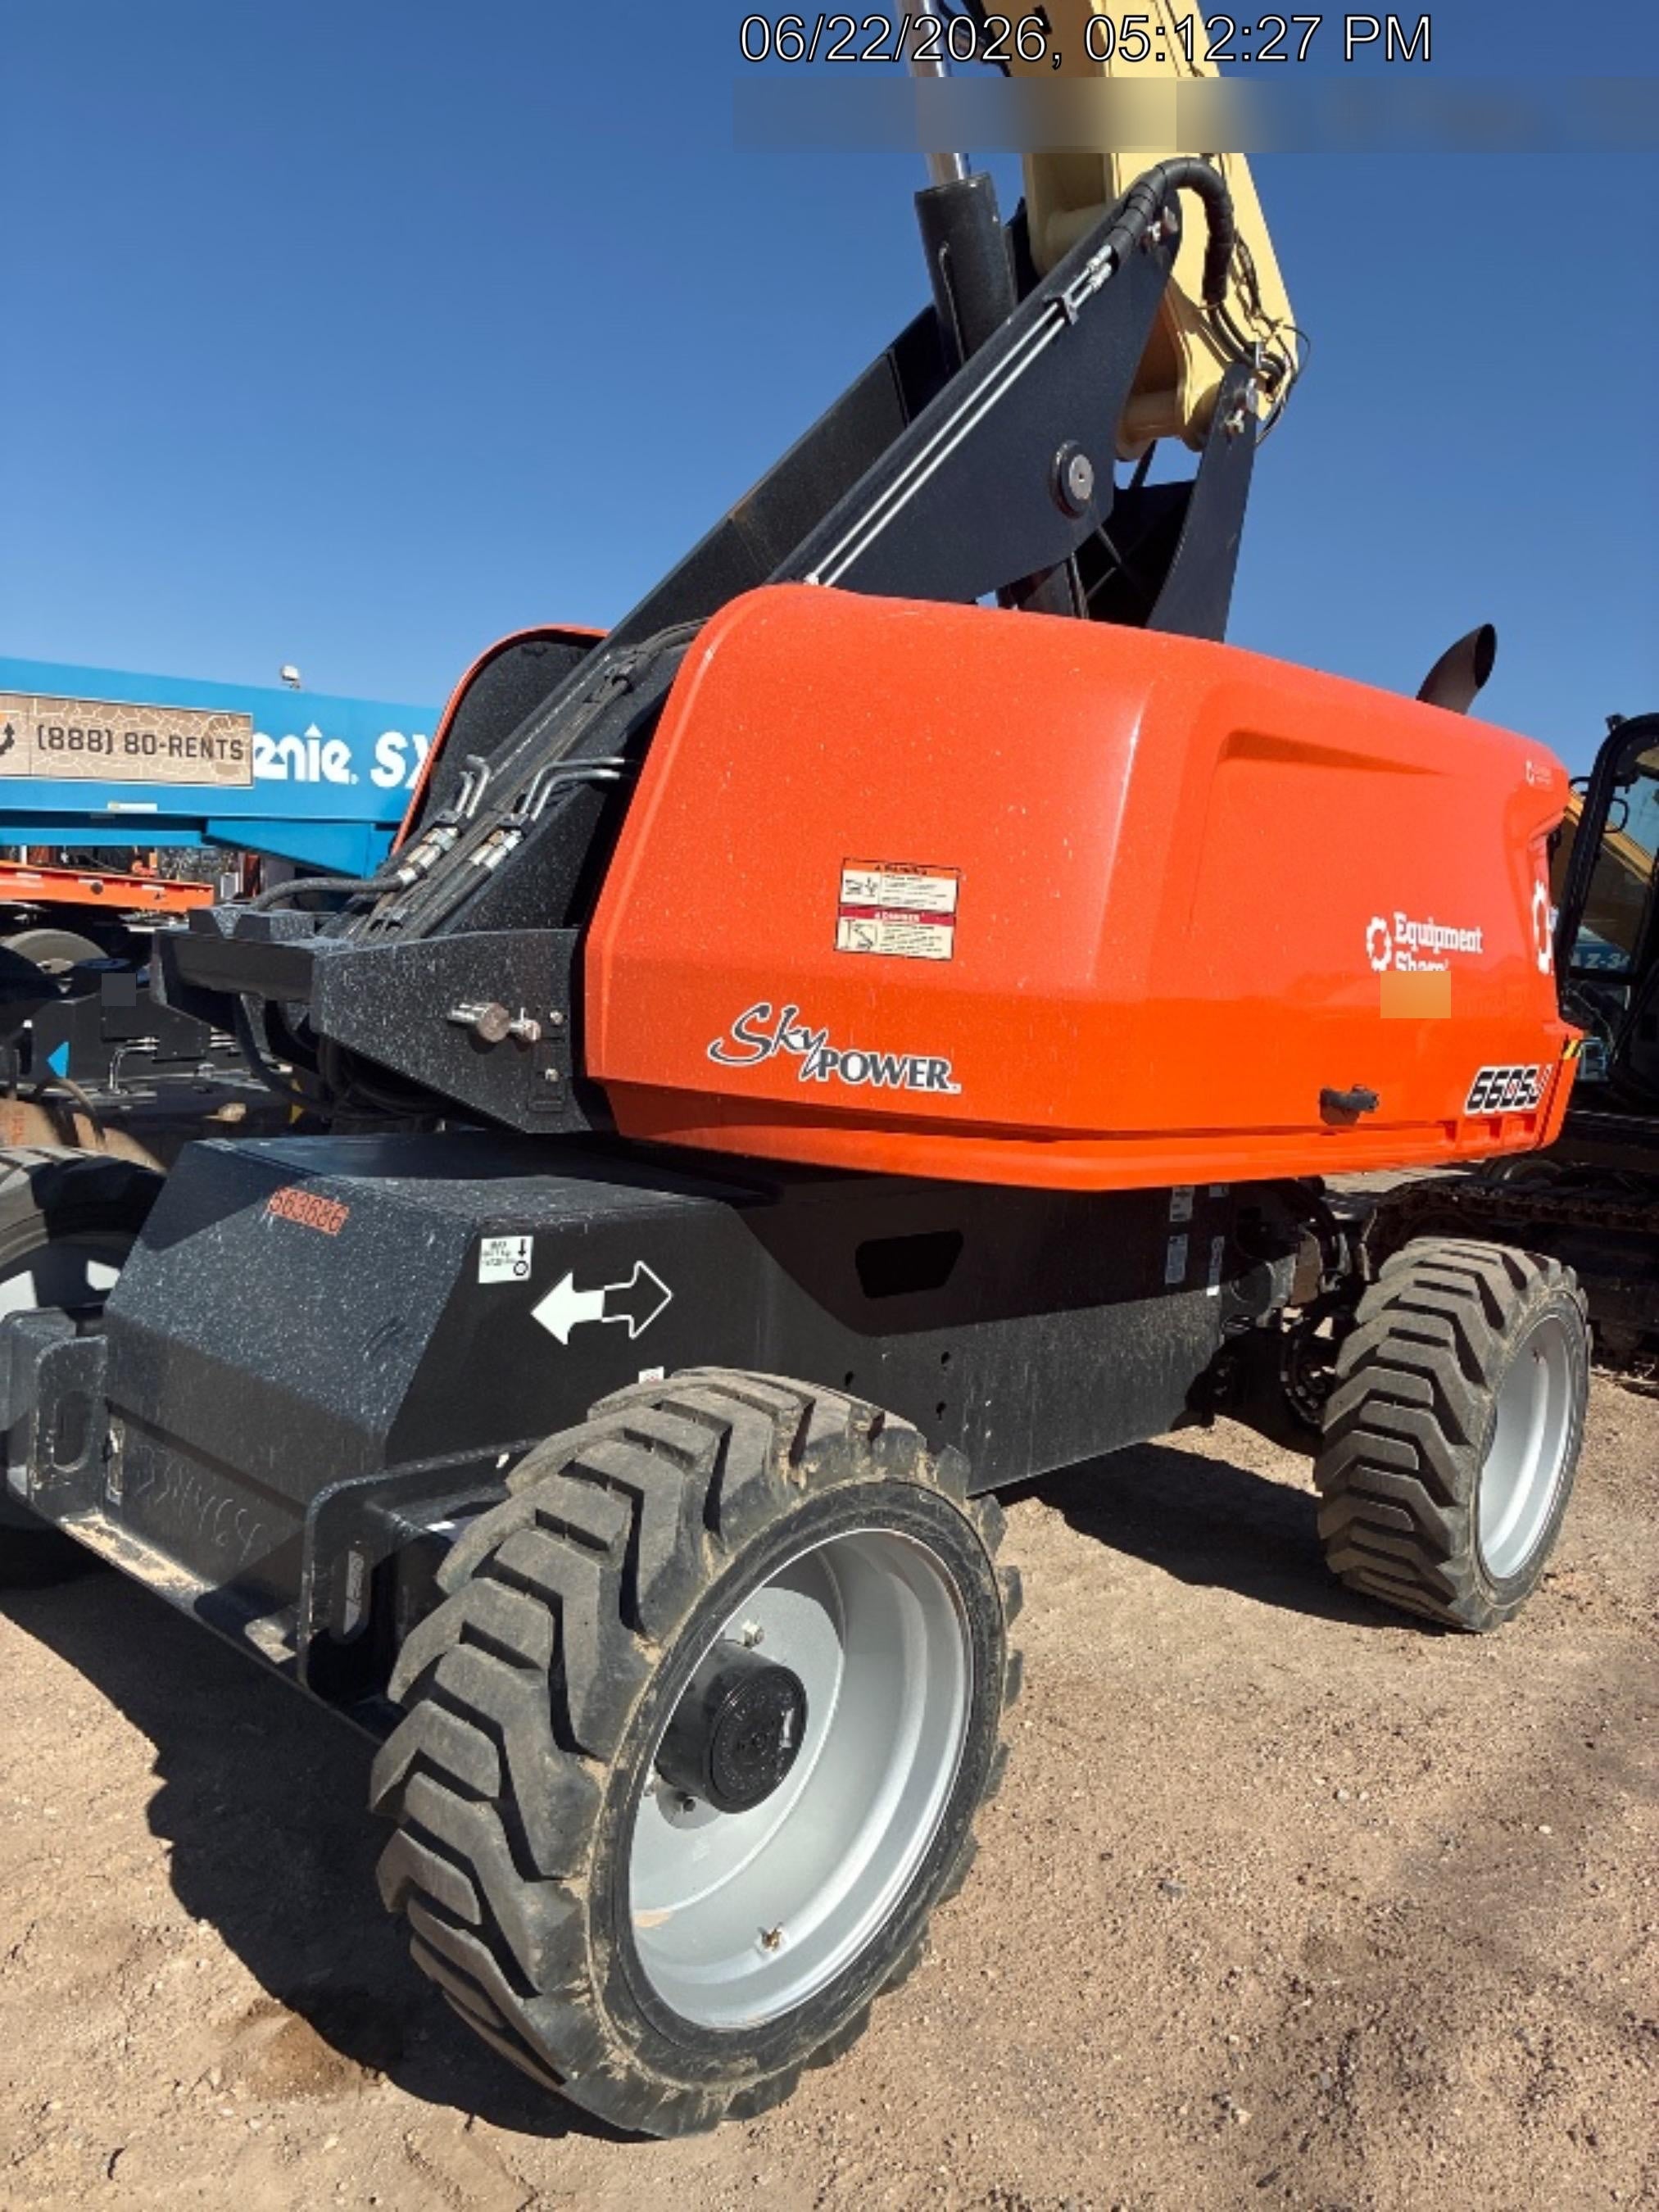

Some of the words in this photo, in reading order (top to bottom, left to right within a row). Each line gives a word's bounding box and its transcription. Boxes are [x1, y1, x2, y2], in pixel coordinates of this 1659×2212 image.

[37, 723, 113, 755] (888)
[124, 732, 244, 761] 80-RENTS
[253, 722, 352, 786] enie
[1393, 910, 1484, 954] Equipment
